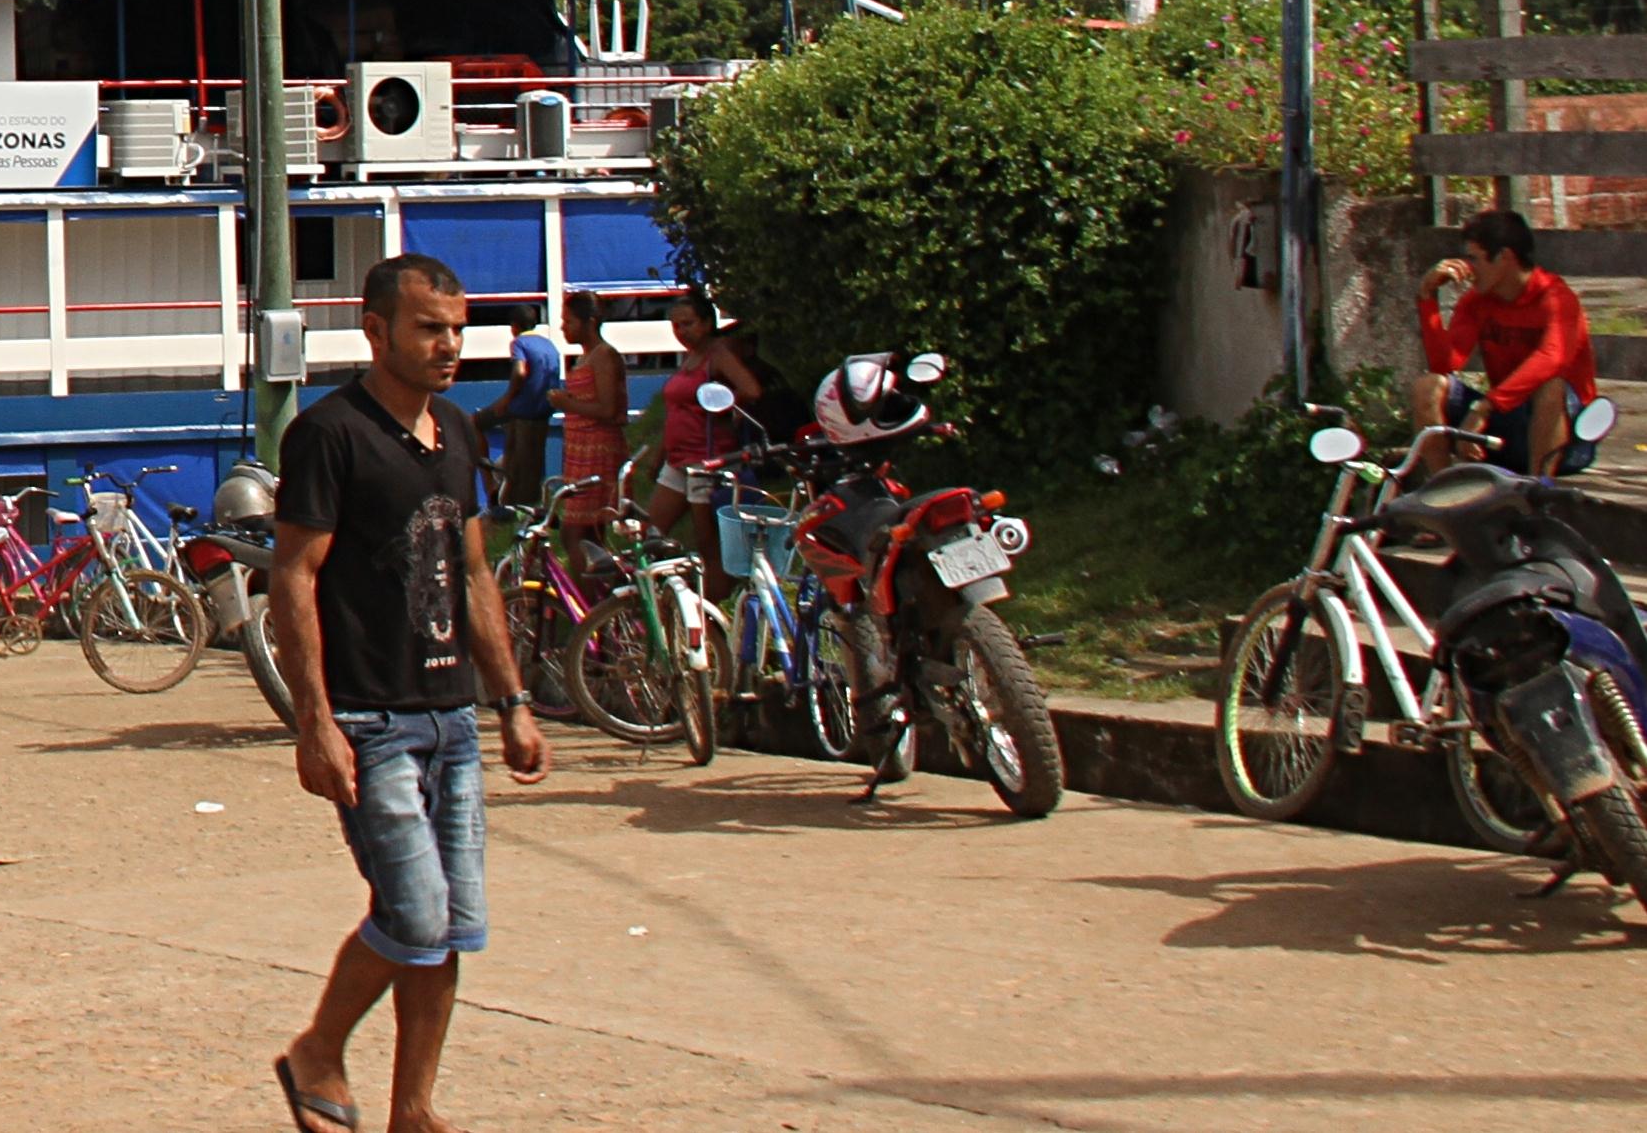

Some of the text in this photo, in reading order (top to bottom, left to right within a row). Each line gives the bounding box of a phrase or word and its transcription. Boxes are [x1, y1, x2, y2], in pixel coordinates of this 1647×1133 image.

[9, 116, 48, 126] ESTADO
[50, 116, 66, 126] DO
[12, 155, 58, 168] Pessoas
